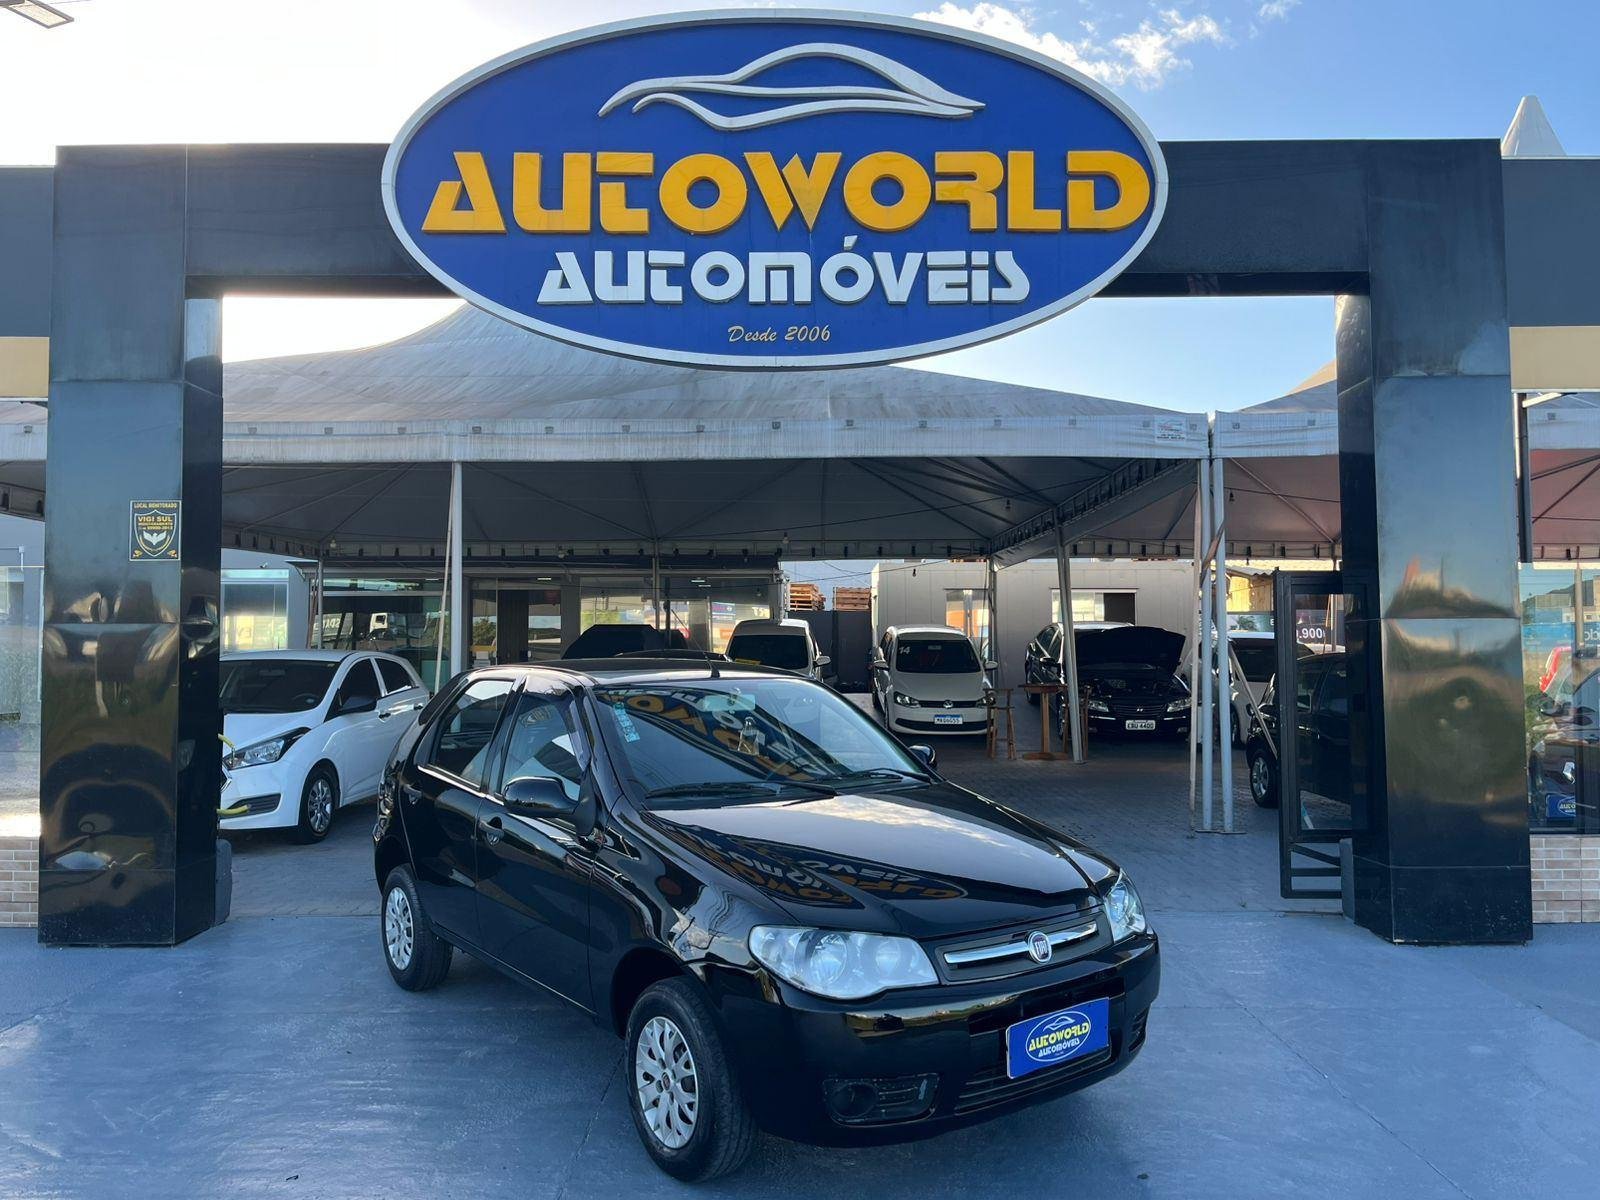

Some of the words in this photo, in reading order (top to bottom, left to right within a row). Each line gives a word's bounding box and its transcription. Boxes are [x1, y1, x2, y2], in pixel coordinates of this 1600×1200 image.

[421, 151, 1151, 234] AUTOWORLD
[536, 235, 1031, 305] AUTOMÓVEIS
[727, 325, 777, 343] Desde
[784, 324, 831, 342] 2006
[1029, 1022, 1090, 1051] AUTOWORLD
